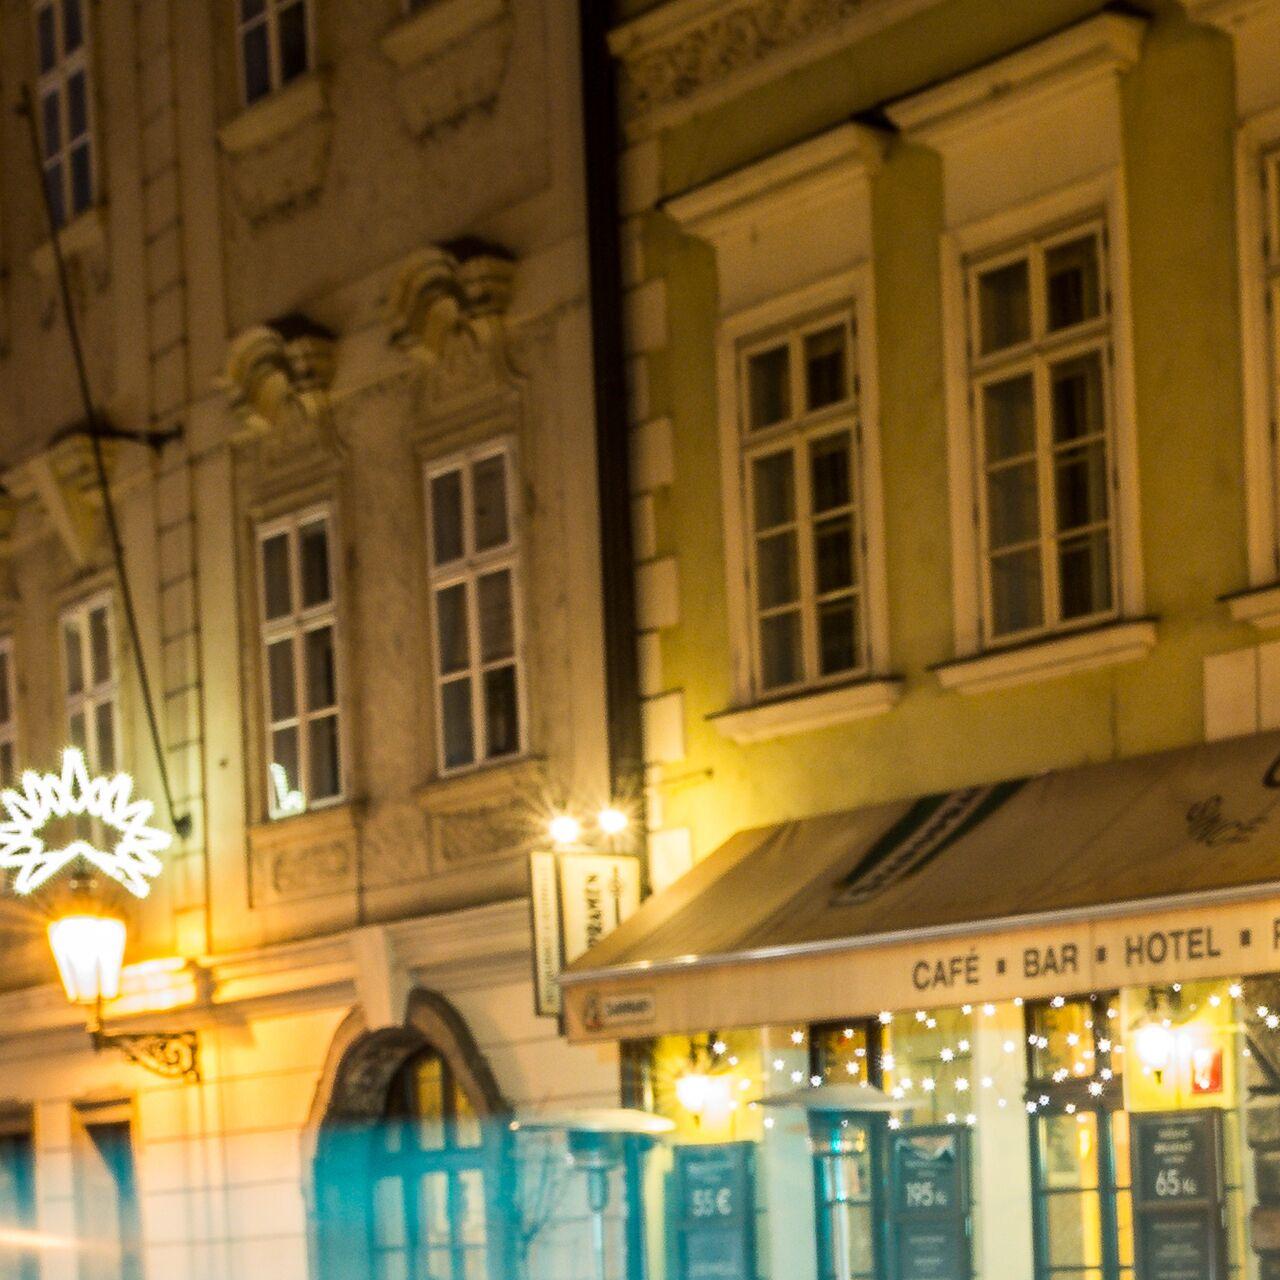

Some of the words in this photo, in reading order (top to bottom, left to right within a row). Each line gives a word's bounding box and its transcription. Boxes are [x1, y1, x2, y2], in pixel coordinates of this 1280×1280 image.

[911, 946, 980, 991] CAFÉ
[1022, 942, 1079, 979] BAR
[1124, 926, 1221, 967] HOTEL
